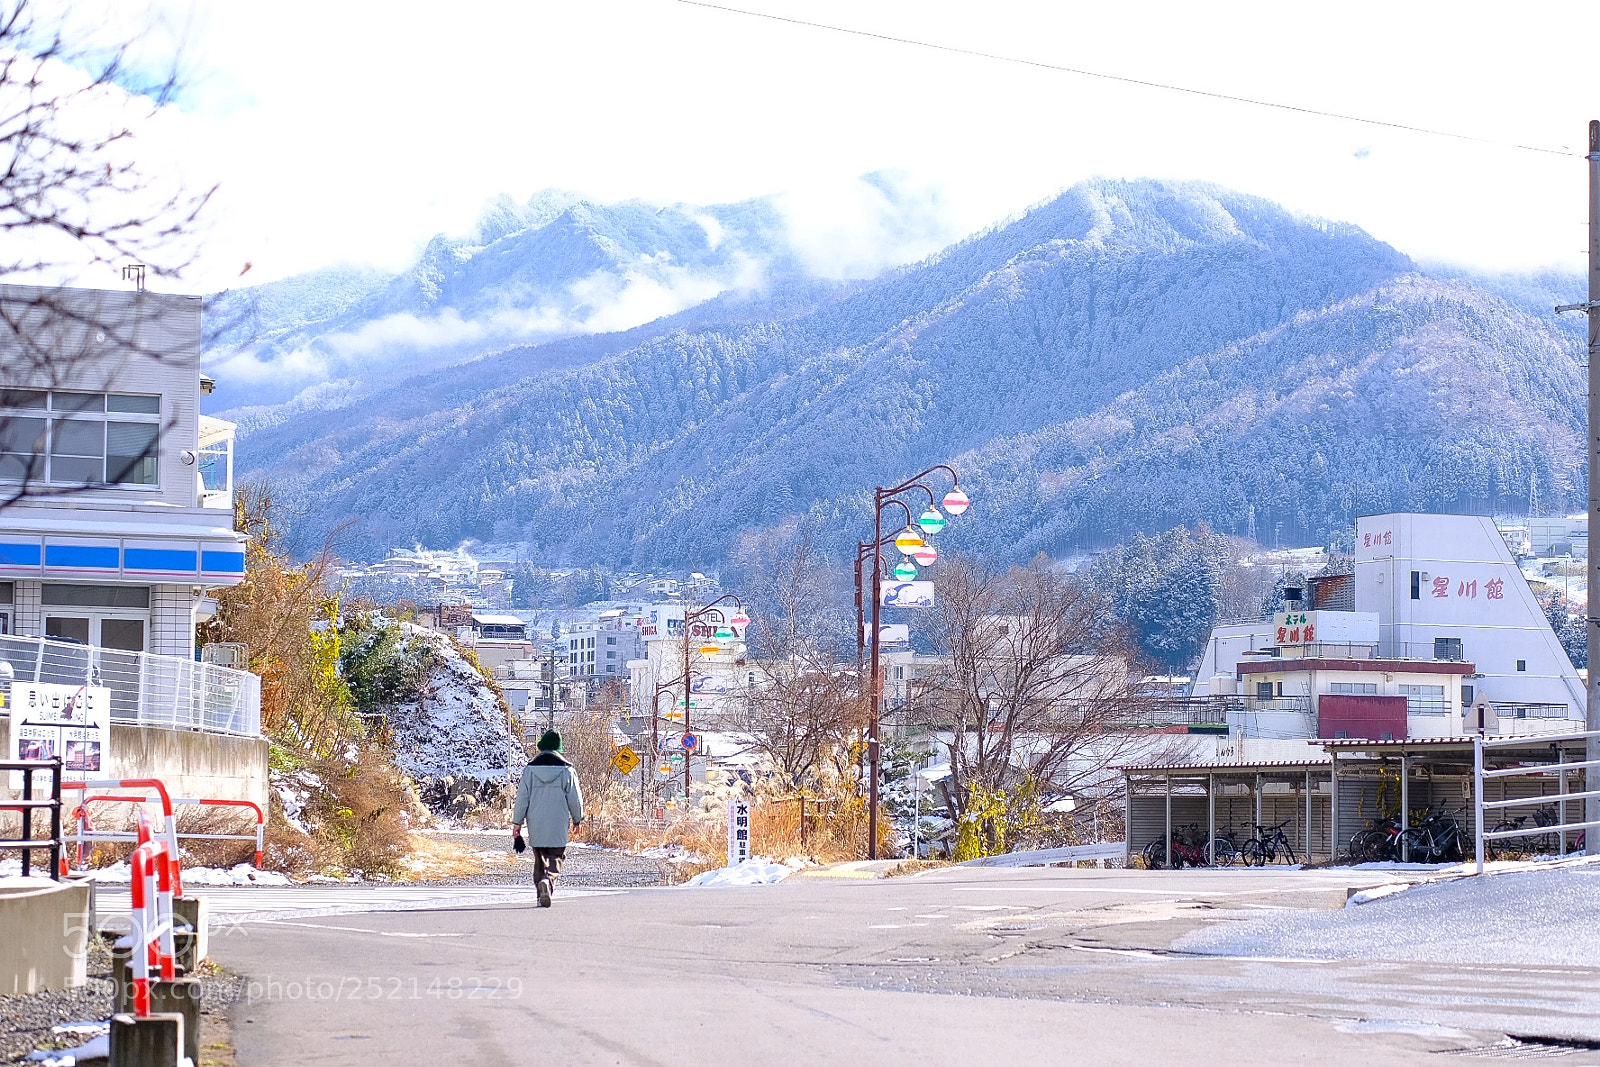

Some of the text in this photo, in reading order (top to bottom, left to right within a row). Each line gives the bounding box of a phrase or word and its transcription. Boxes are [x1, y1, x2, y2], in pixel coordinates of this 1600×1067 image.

[1363, 530, 1392, 548] 星川館
[1431, 576, 1505, 600] 星川館
[1285, 613, 1307, 626] ホテル
[692, 625, 740, 637] SHIA
[1276, 624, 1315, 643] 星川館
